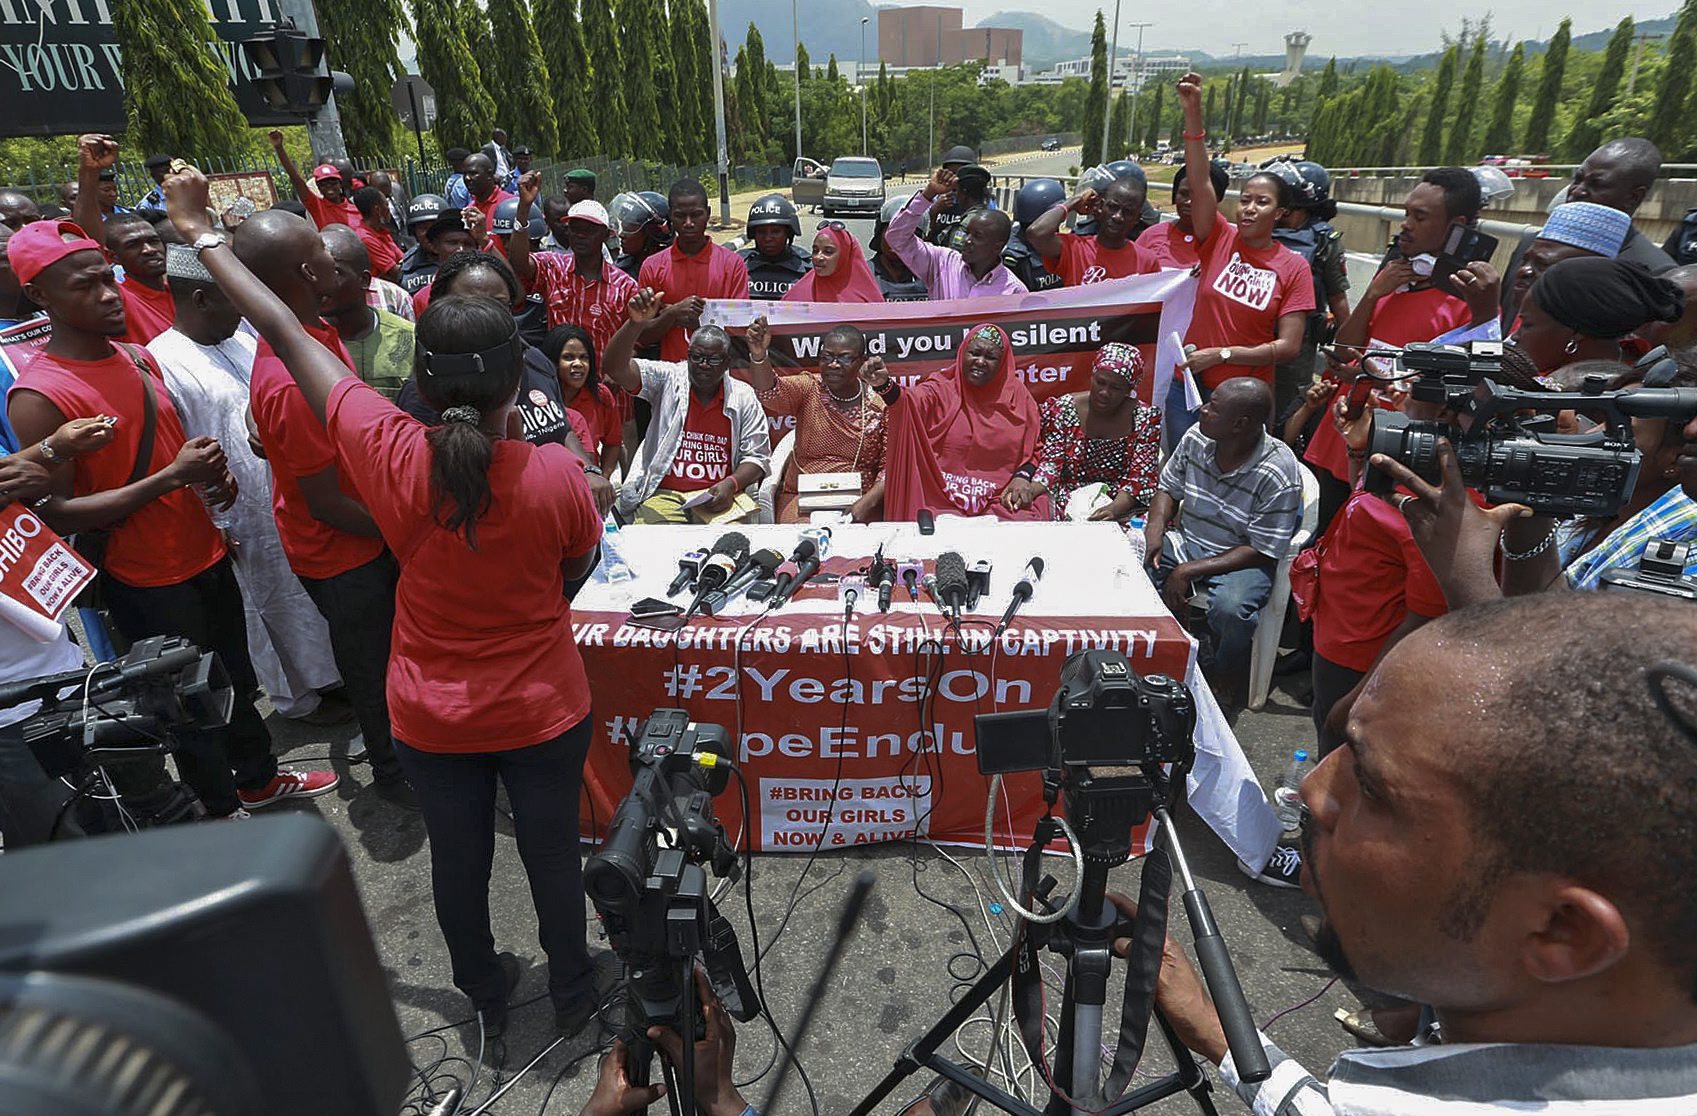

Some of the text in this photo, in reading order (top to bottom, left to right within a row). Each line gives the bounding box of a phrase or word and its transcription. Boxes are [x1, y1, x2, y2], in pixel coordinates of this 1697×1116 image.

[2, 43, 105, 91] YOUR
[409, 202, 440, 213] POLICE
[751, 205, 781, 215] POLICE
[407, 275, 436, 289] POLI
[1217, 273, 1268, 306] NOW
[26, 328, 42, 338] OUR
[897, 334, 951, 358] you
[1011, 320, 1101, 347] silent
[518, 400, 563, 431] lieve
[682, 440, 726, 453] RING BACK
[676, 448, 728, 463] UR GIRLS
[666, 462, 728, 480] NOW
[971, 477, 998, 489] BACK
[44, 548, 64, 569] BACK
[40, 561, 69, 596] OUR GIRLS
[45, 591, 60, 608] NOW
[61, 566, 82, 588] ALIVE
[571, 623, 610, 646] UR
[613, 624, 792, 653] DAUGHTERS
[800, 624, 860, 655] ARE
[1001, 628, 1157, 658] CAPTIVITY
[663, 663, 1031, 704] #2YearsOn
[769, 784, 923, 801] #BRING BACK
[786, 808, 906, 823] OUR GIRLS
[773, 829, 916, 846] NOW & ALIVE
